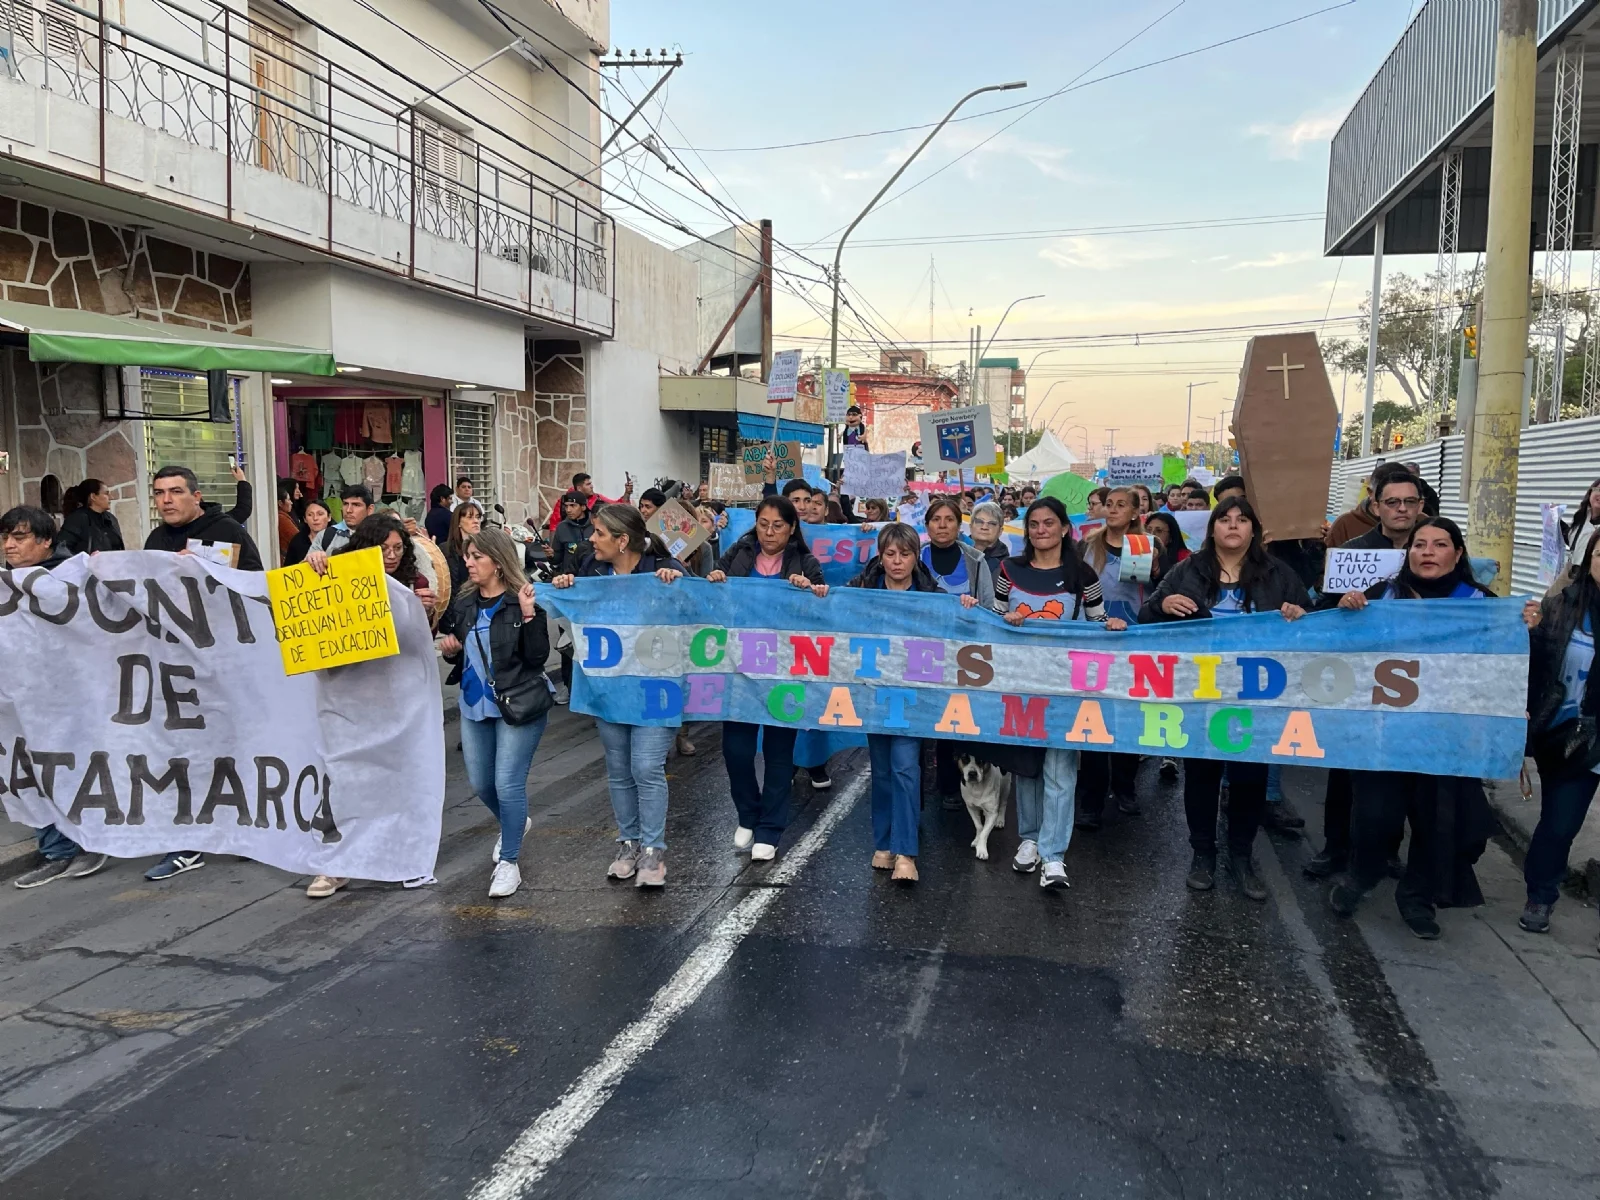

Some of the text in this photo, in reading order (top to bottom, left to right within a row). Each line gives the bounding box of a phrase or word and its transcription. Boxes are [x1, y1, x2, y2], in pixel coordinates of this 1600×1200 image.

[743, 443, 788, 462] ABAO
[945, 446, 971, 457] J N
[1121, 460, 1154, 468] maestro
[812, 538, 879, 564] EST
[1335, 552, 1382, 563] JALIL
[283, 562, 339, 592] NO AL
[1337, 563, 1377, 575] TUVO
[279, 574, 380, 621] DECRETO 884
[275, 600, 392, 643] DEVUELVAN LA PLATA
[290, 625, 389, 664] DE EDUCACIÓN
[582, 626, 1421, 708] DOCENTES UNIDOS
[111, 653, 207, 730] DE
[640, 674, 1325, 758] DE CATAMARCA
[0, 736, 342, 844] ATAMARCA
